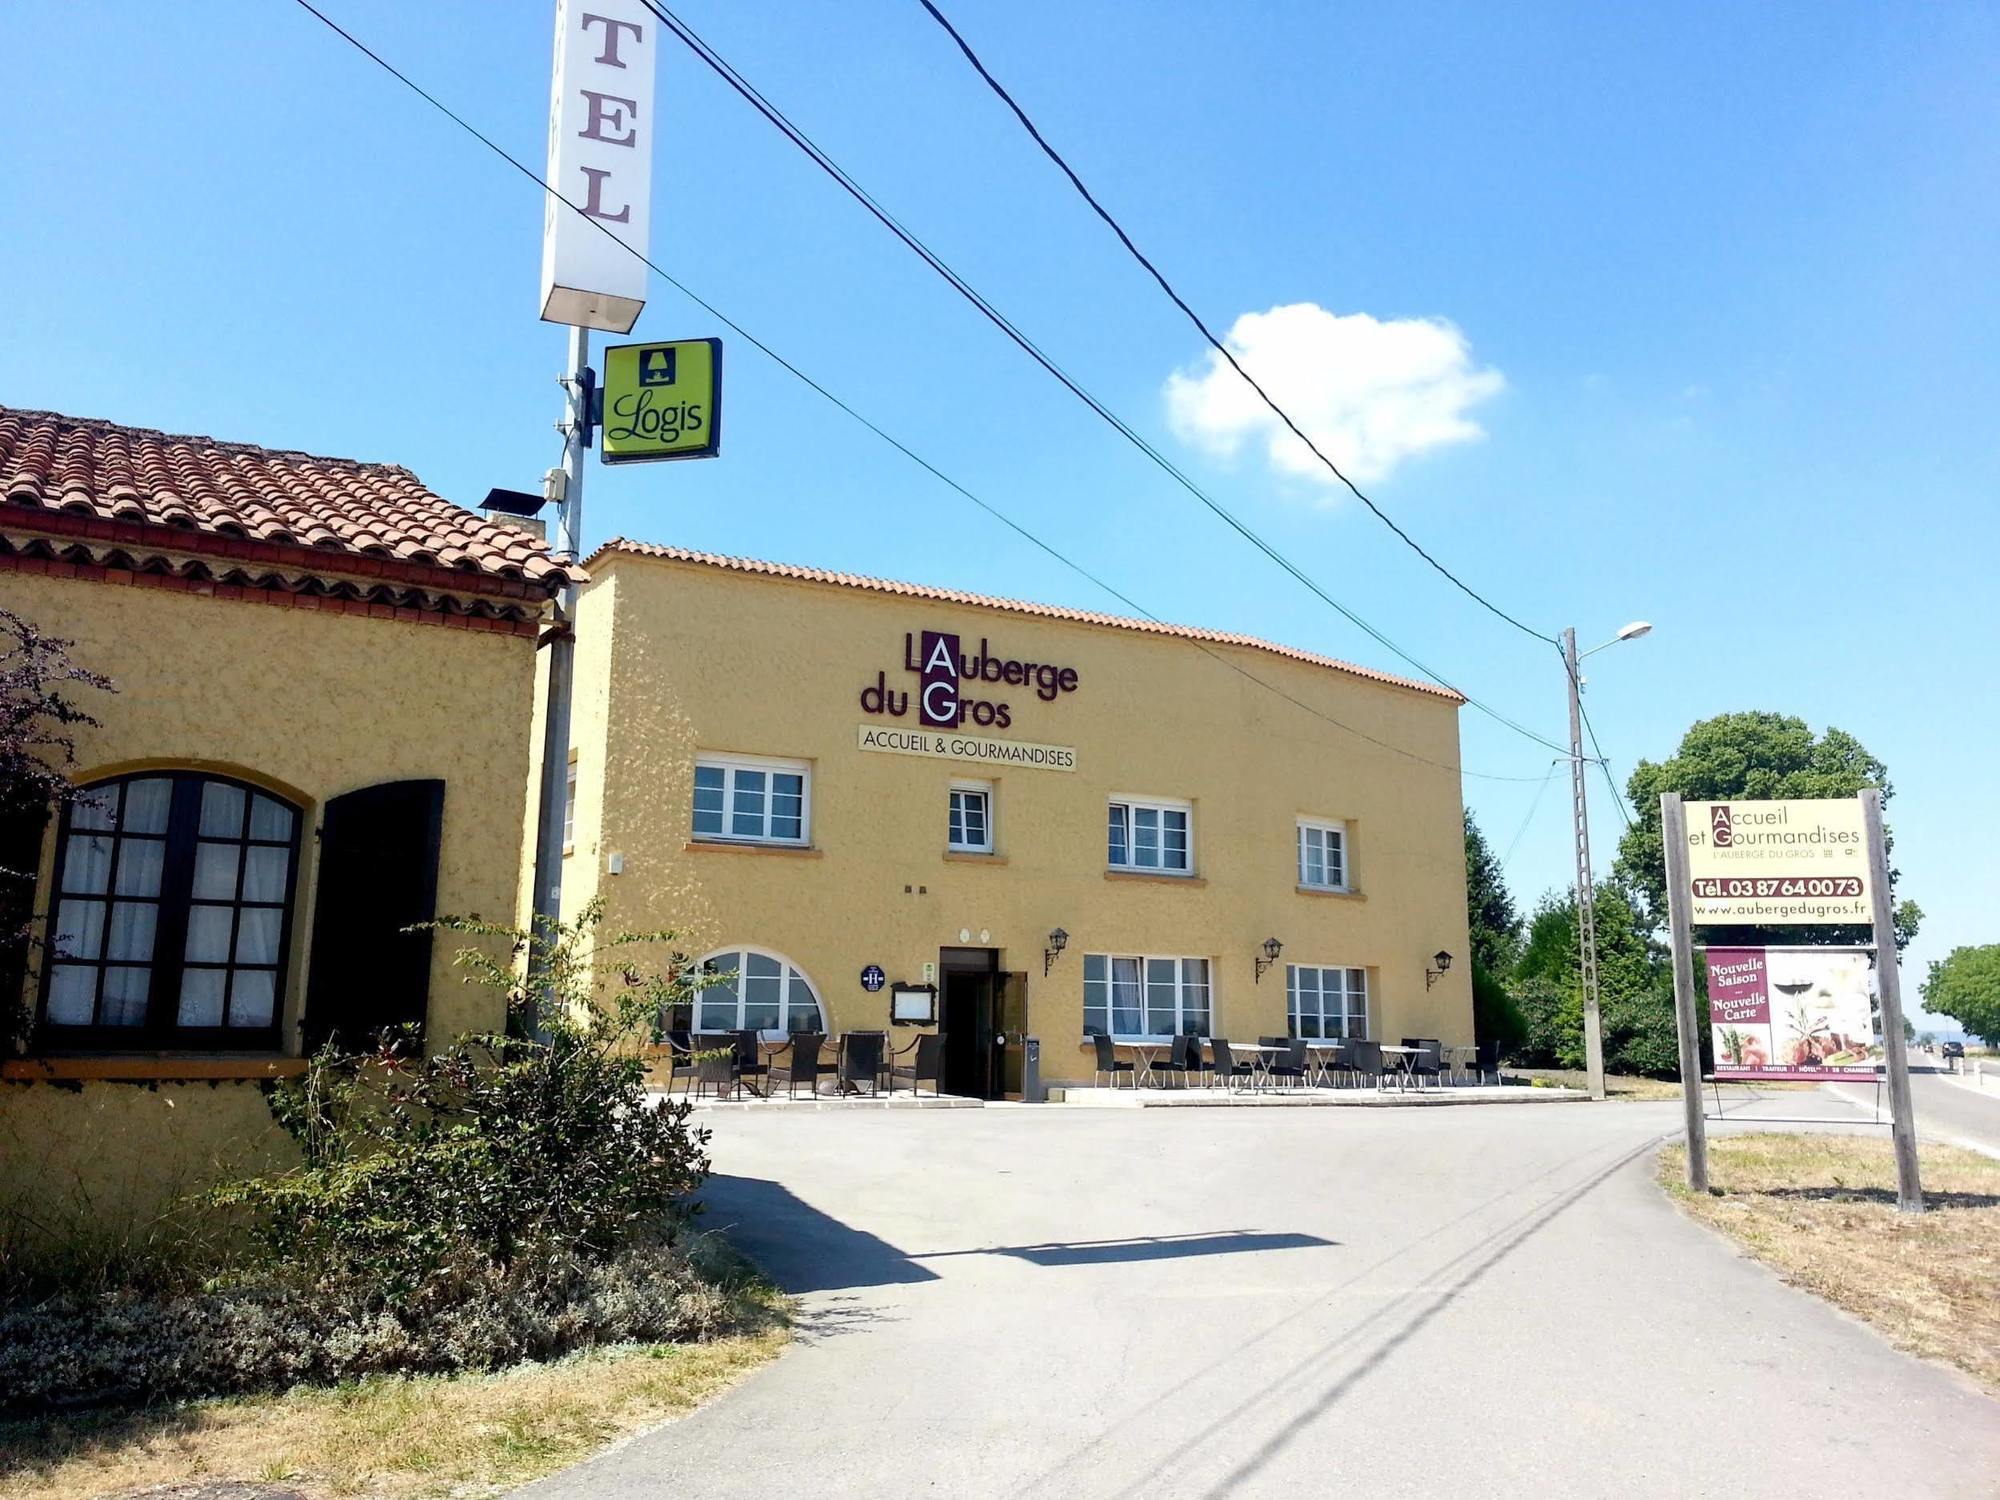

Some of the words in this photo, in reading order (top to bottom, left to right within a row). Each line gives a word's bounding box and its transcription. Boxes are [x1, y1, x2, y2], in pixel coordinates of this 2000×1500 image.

[608, 389, 703, 443] Logis
[861, 671, 908, 716] du
[922, 681, 1012, 728] Gros
[864, 731, 930, 752] ACCUEIL
[935, 739, 946, 753] &
[951, 740, 1073, 767] GOURMANDISES
[1713, 806, 1788, 826] Accueil
[1689, 831, 1706, 845] et
[1713, 825, 1860, 846] Gourmandises
[1769, 850, 1782, 859] DU
[1785, 849, 1815, 858] GROS
[1696, 879, 1727, 897] Tél.
[1694, 901, 1866, 917] www.aubergedugros.fr
[1711, 958, 1763, 977] Nouvelle
[868, 973, 878, 984] H
[1718, 973, 1757, 987] Saison
[1713, 992, 1766, 1011] Nouvelle
[1724, 1008, 1757, 1021] Carte
